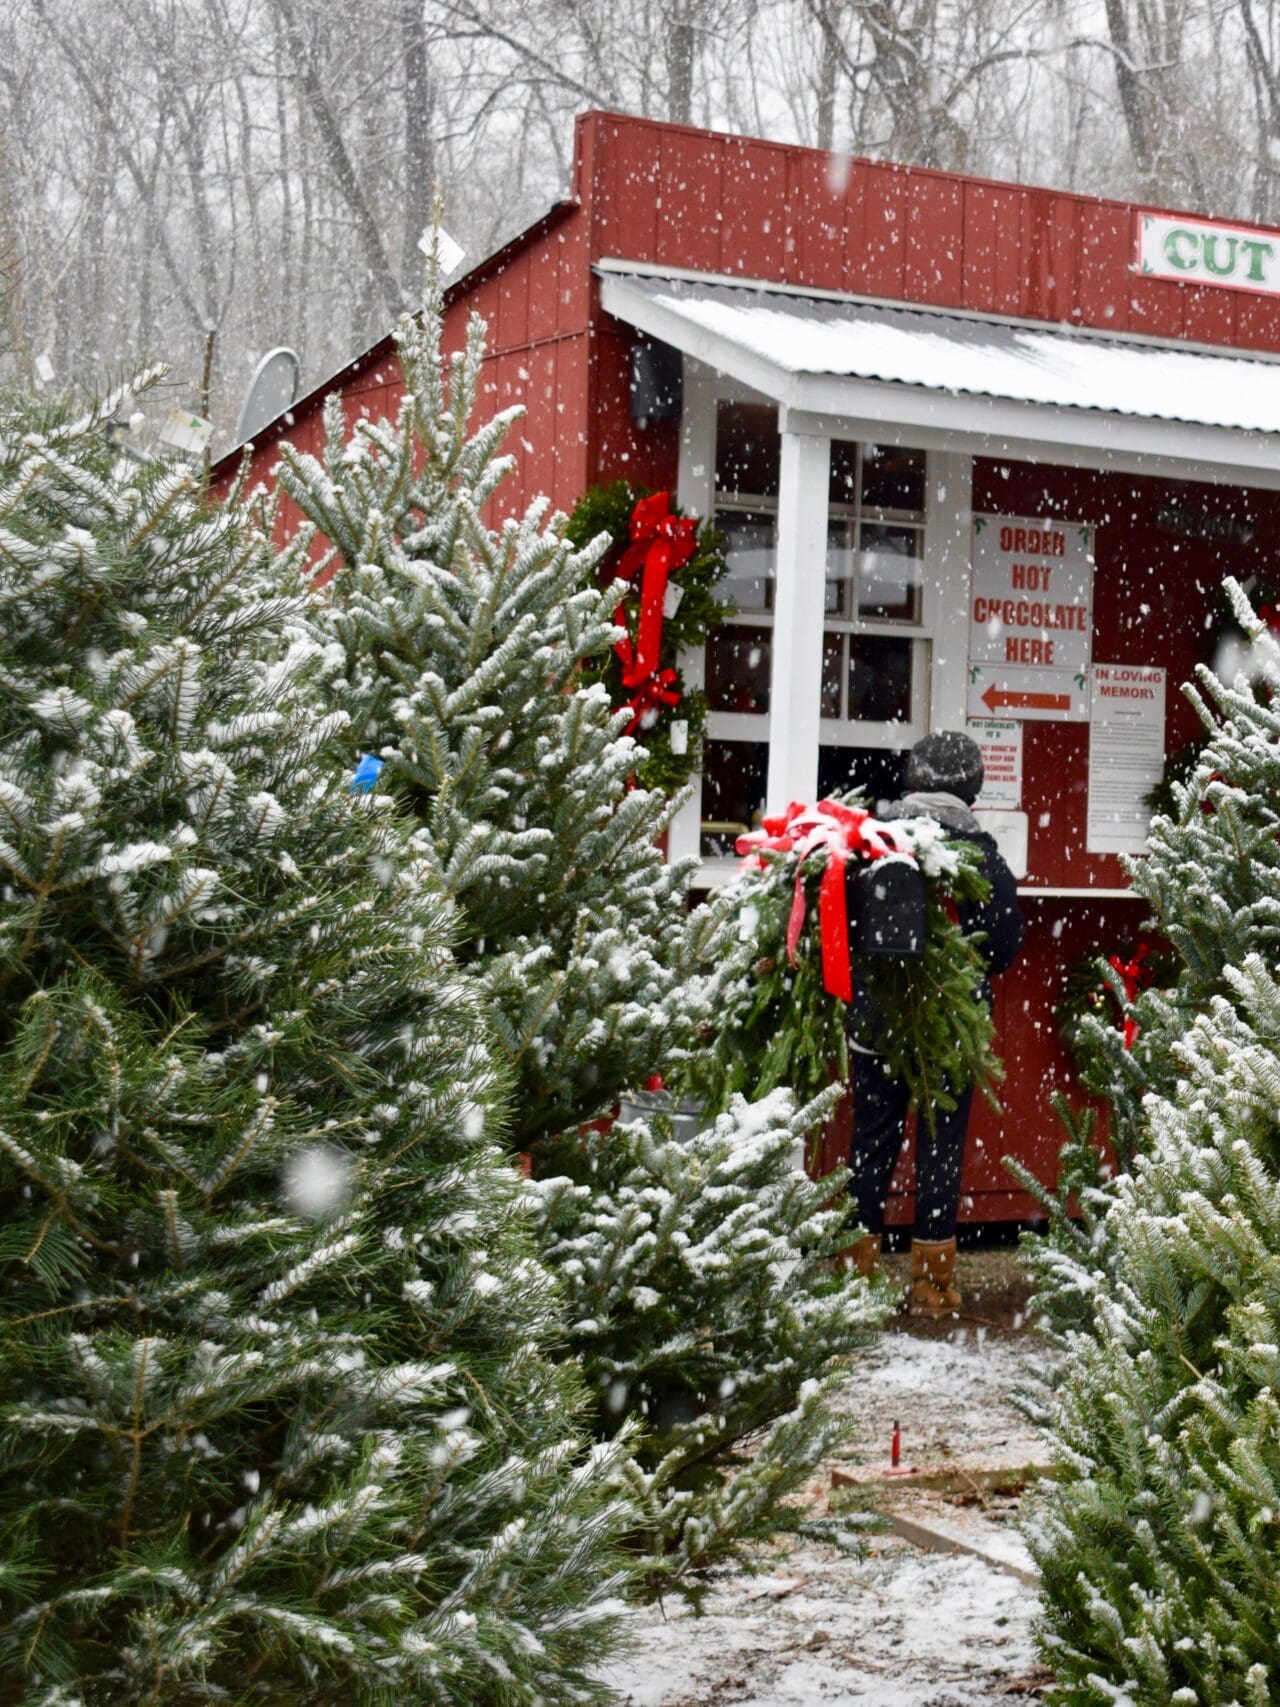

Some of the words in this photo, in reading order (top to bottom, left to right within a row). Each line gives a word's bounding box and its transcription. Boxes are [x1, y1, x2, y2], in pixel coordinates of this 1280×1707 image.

[1162, 229, 1274, 282] CUT
[1000, 526, 1065, 557] ORDER
[1012, 564, 1052, 592] HOT
[974, 597, 1087, 632] CHOCOLATE
[1005, 637, 1054, 664] HERE
[1095, 668, 1109, 680] IN
[1113, 669, 1162, 684] LOVING
[1100, 686, 1157, 699] MEMORY
